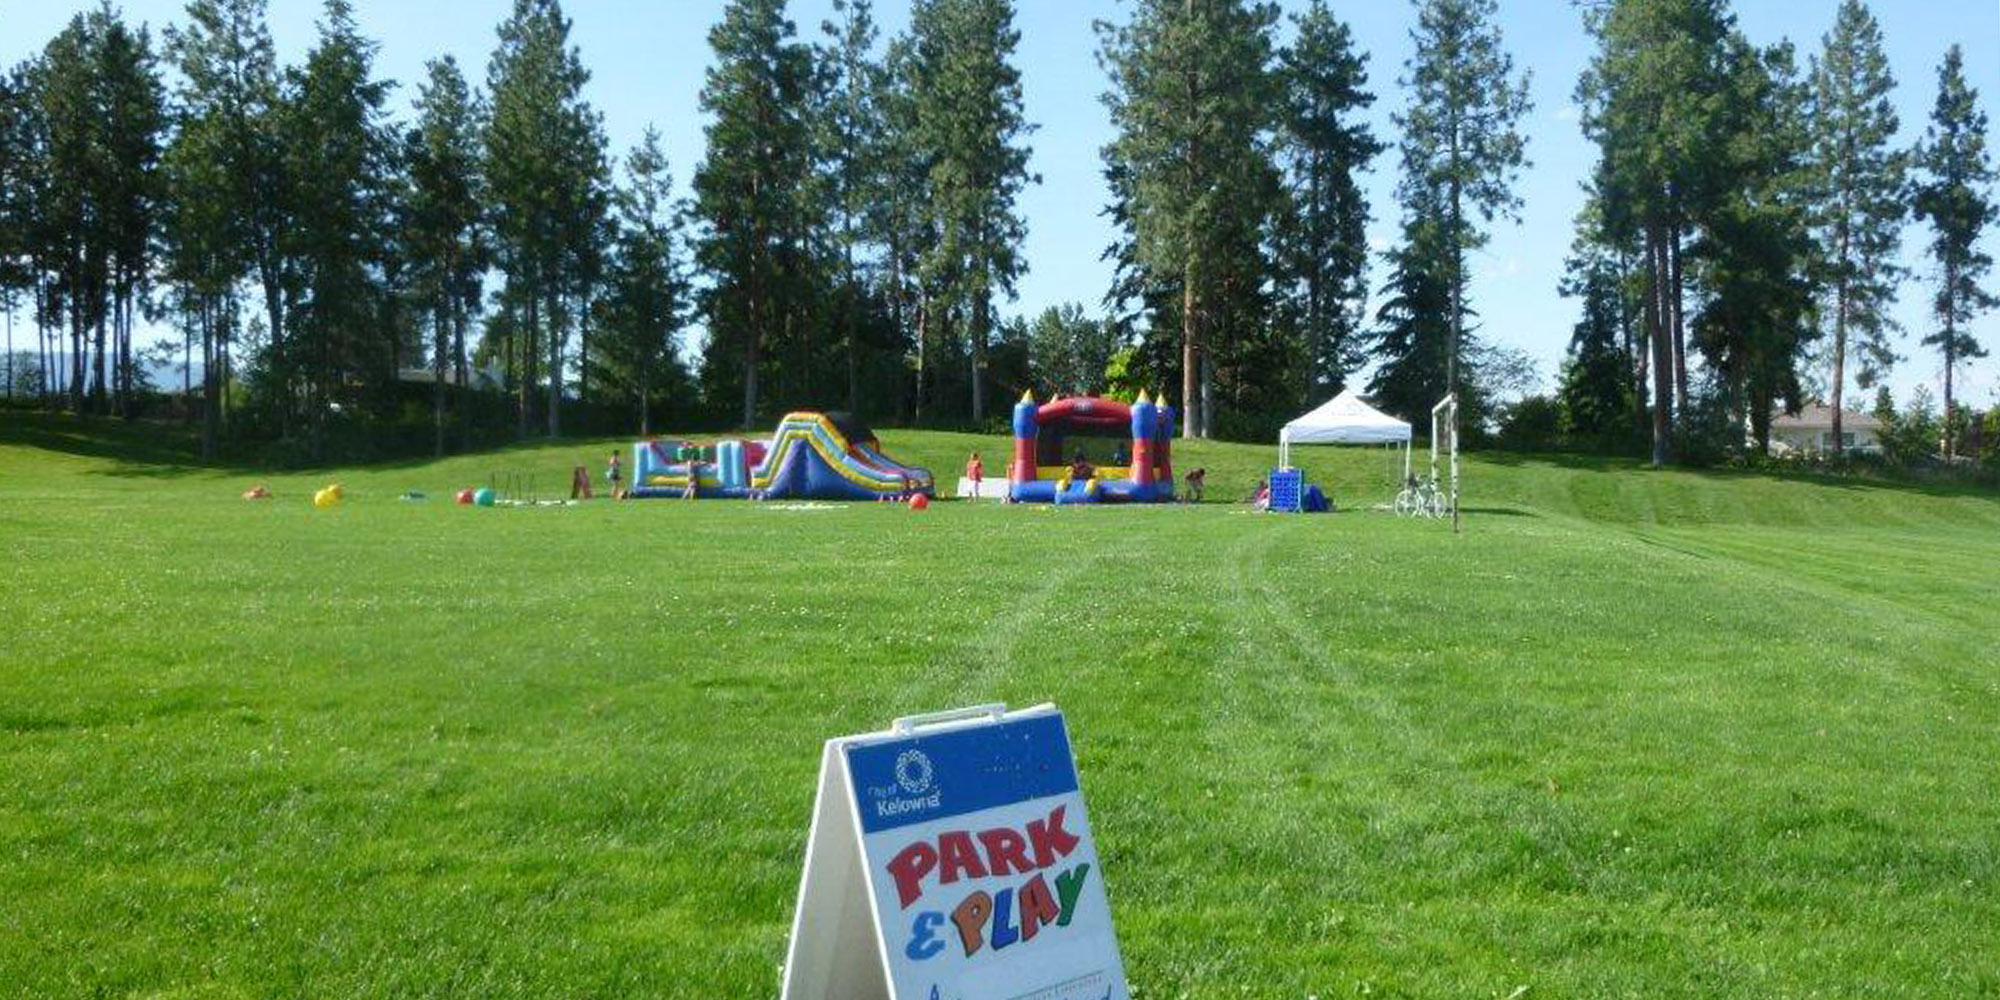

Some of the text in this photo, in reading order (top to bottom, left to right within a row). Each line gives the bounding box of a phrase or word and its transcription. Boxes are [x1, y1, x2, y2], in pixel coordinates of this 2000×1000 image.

[877, 793, 941, 816] Kelowna
[886, 803, 1080, 910] PARK
[950, 862, 1091, 958] PLAY
